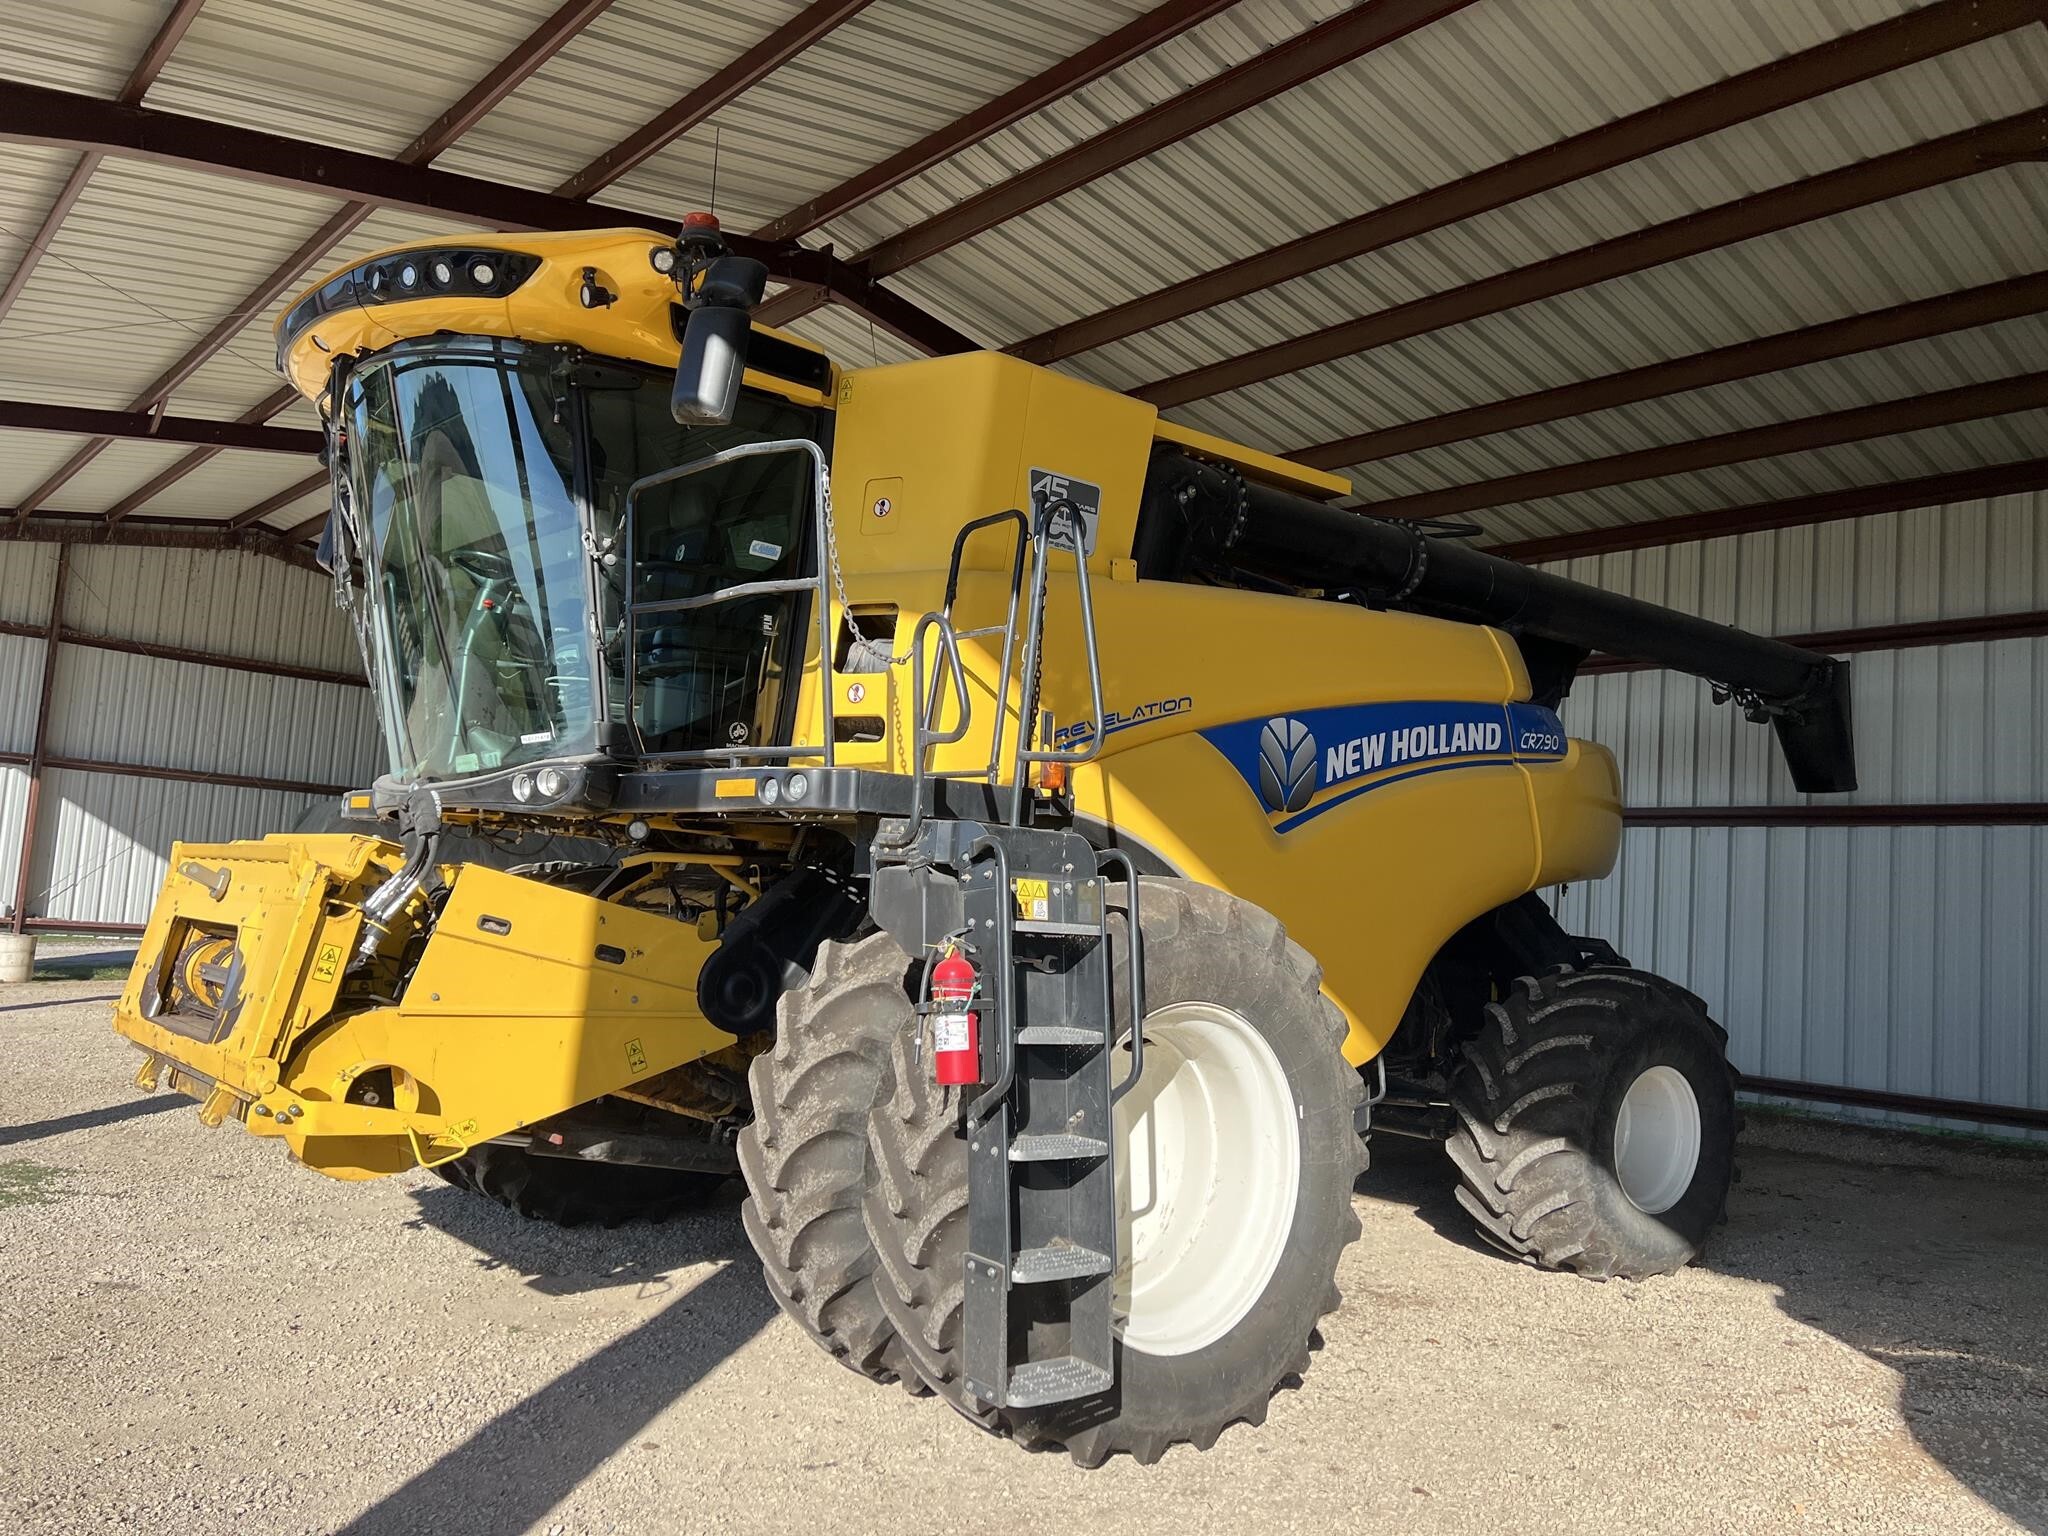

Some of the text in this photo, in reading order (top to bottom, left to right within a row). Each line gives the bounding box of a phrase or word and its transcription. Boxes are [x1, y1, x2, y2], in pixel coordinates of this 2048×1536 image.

[1033, 474, 1070, 502] 45
[1325, 722, 1501, 784] NEW HOLLAND
[1520, 732, 1560, 751] CR7.90
